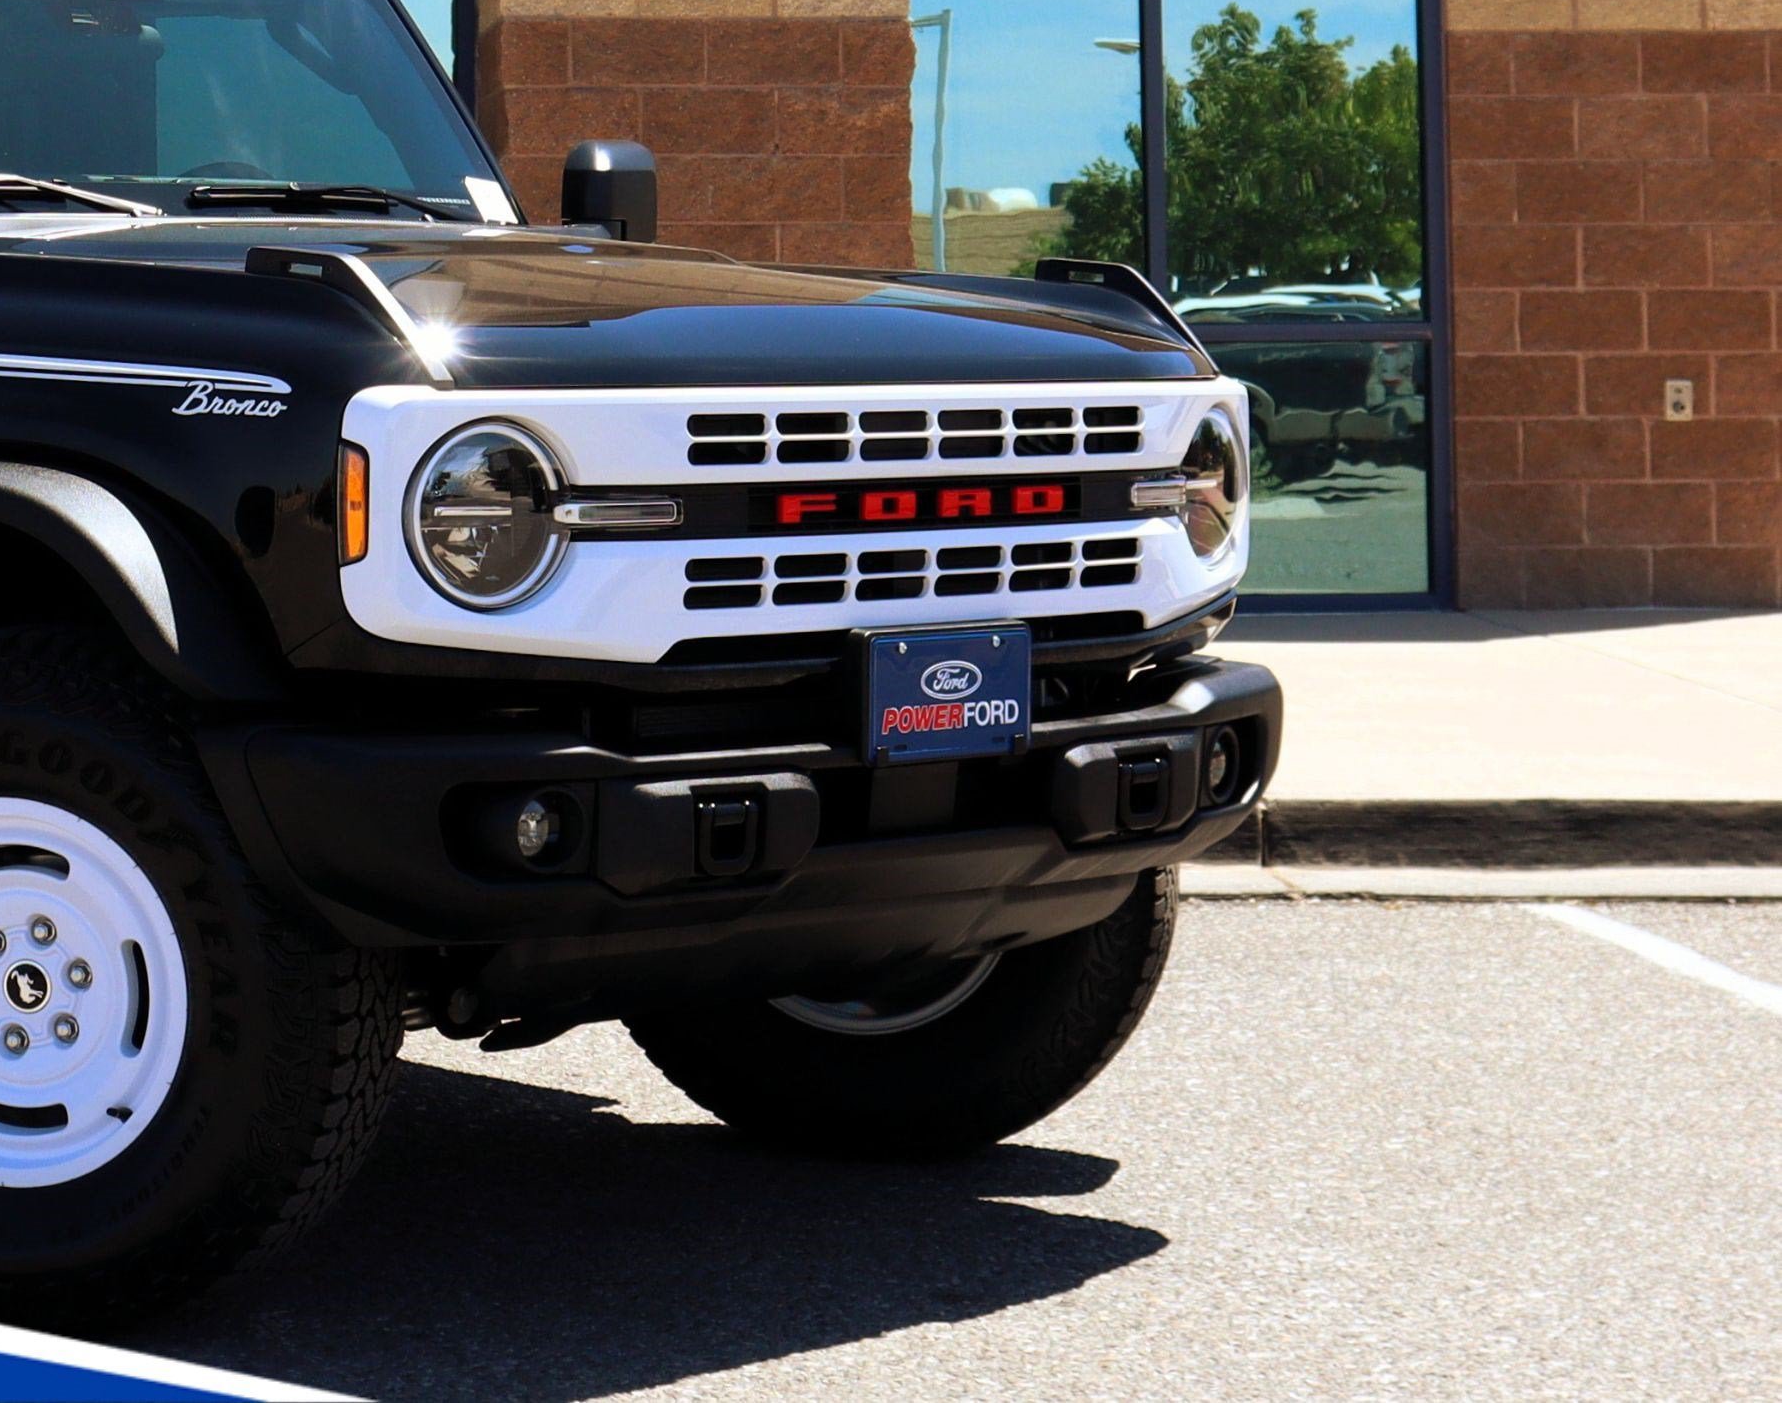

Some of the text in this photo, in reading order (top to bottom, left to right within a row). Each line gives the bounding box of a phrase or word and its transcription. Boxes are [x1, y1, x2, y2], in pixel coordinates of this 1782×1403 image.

[171, 380, 288, 418] Bronco
[776, 484, 1065, 524] FORD
[933, 668, 970, 692] Ford
[881, 699, 1019, 735] POWERFORD
